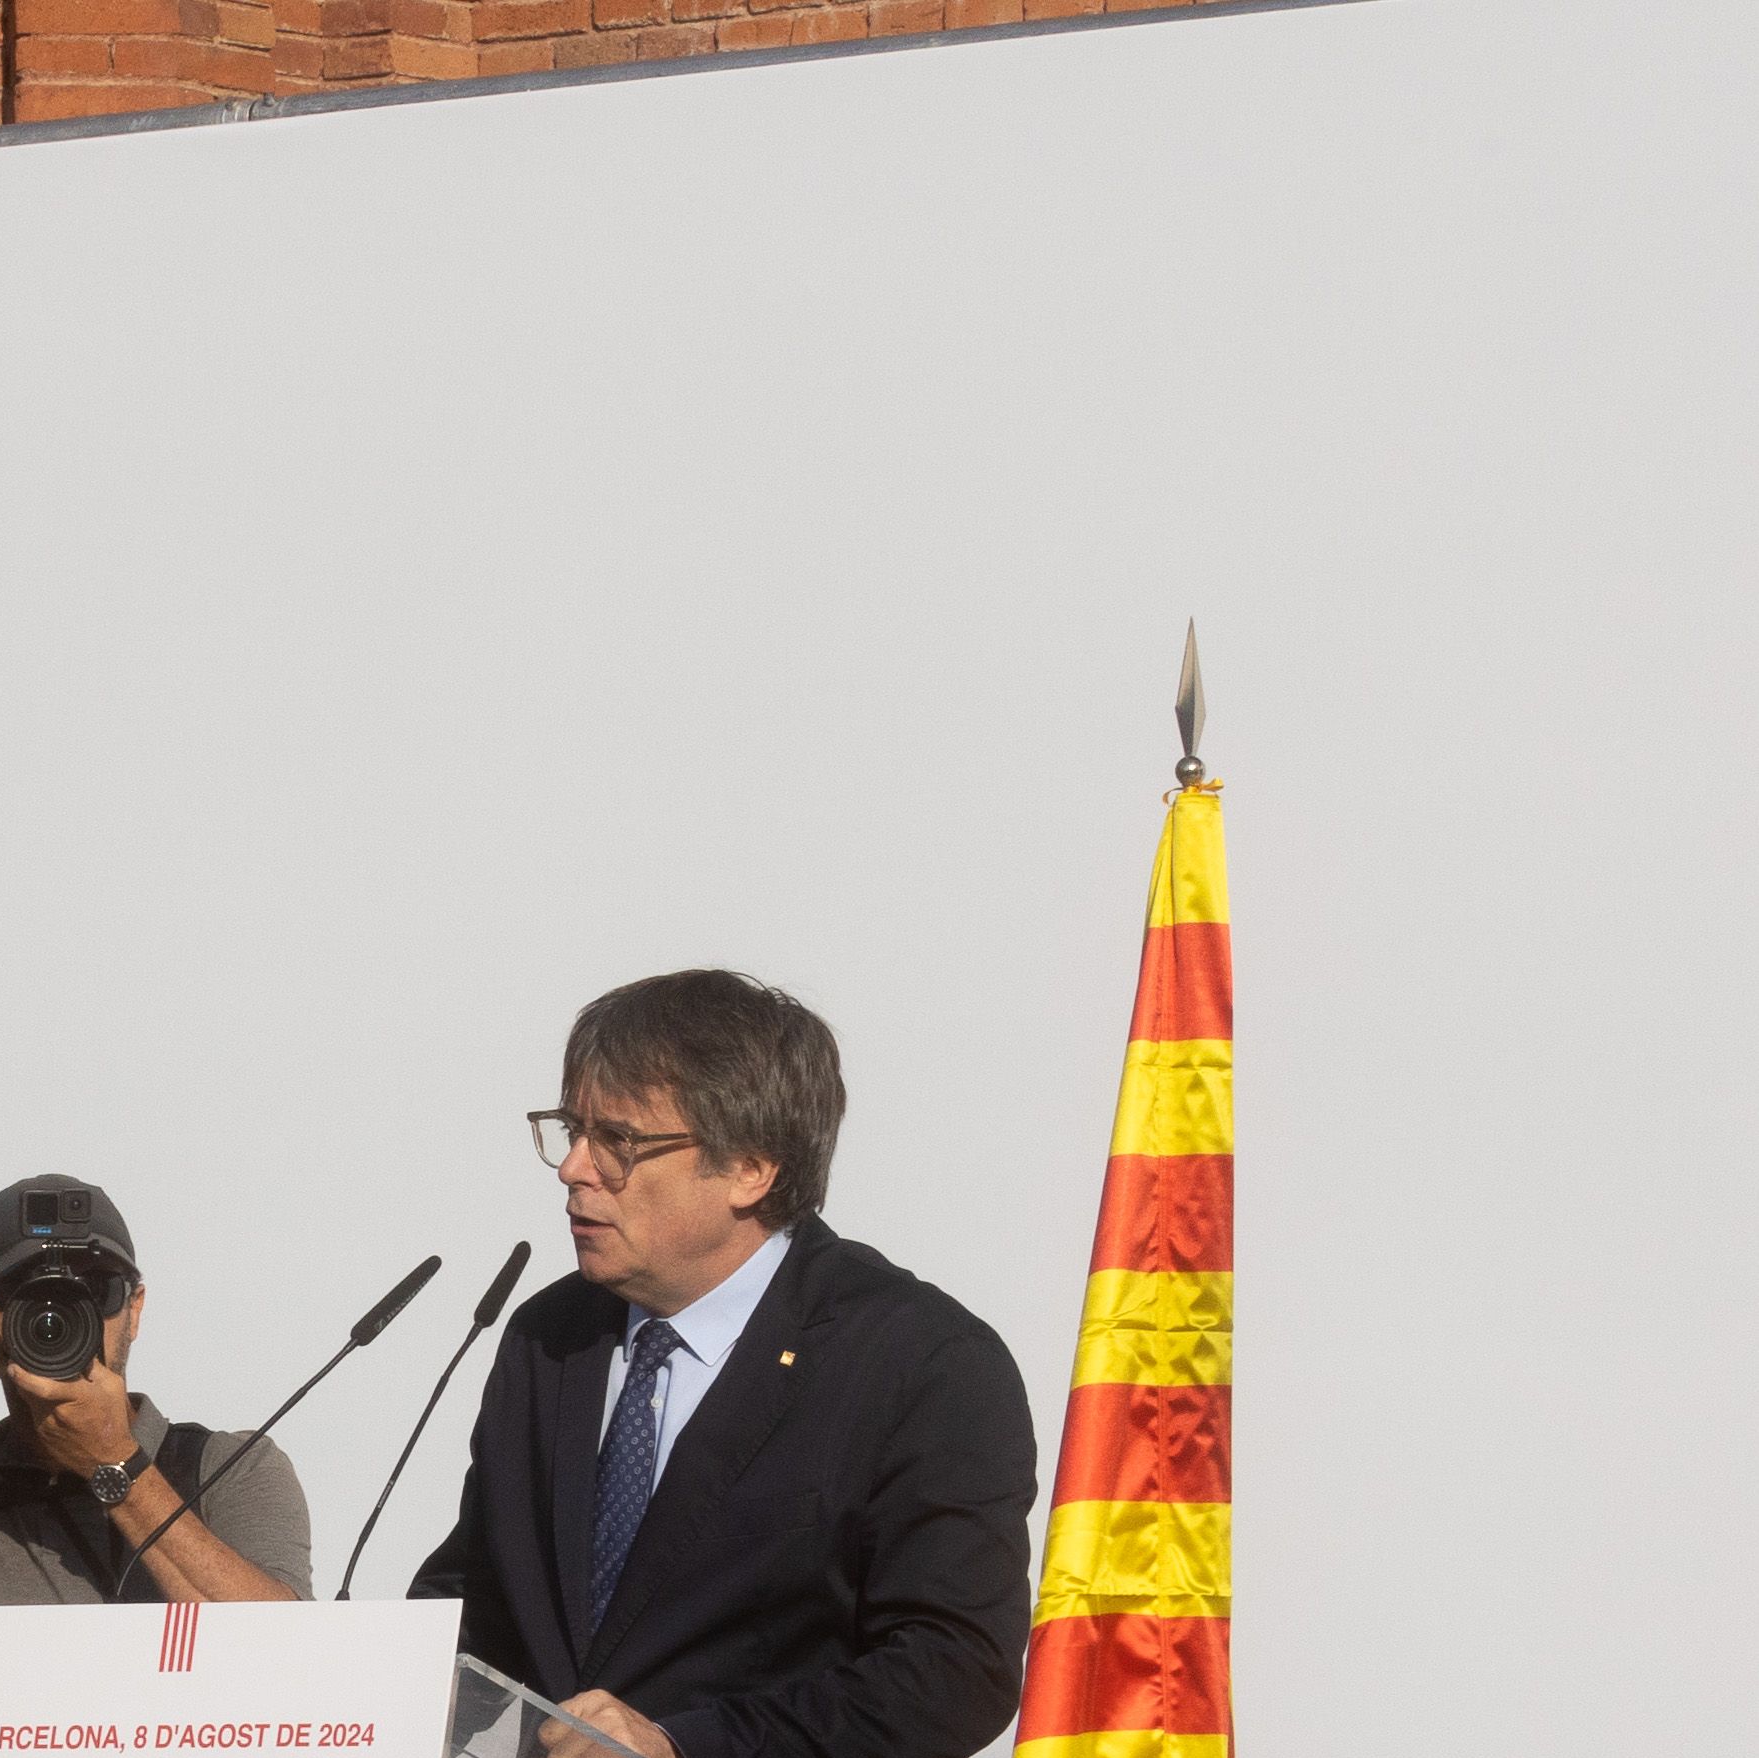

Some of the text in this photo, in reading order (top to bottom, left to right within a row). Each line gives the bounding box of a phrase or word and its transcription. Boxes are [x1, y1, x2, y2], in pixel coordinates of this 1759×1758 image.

[134, 1725, 147, 1749] 8
[155, 1723, 271, 1748] D'AGOST
[276, 1723, 312, 1747] DE
[318, 1723, 375, 1747] 2024
